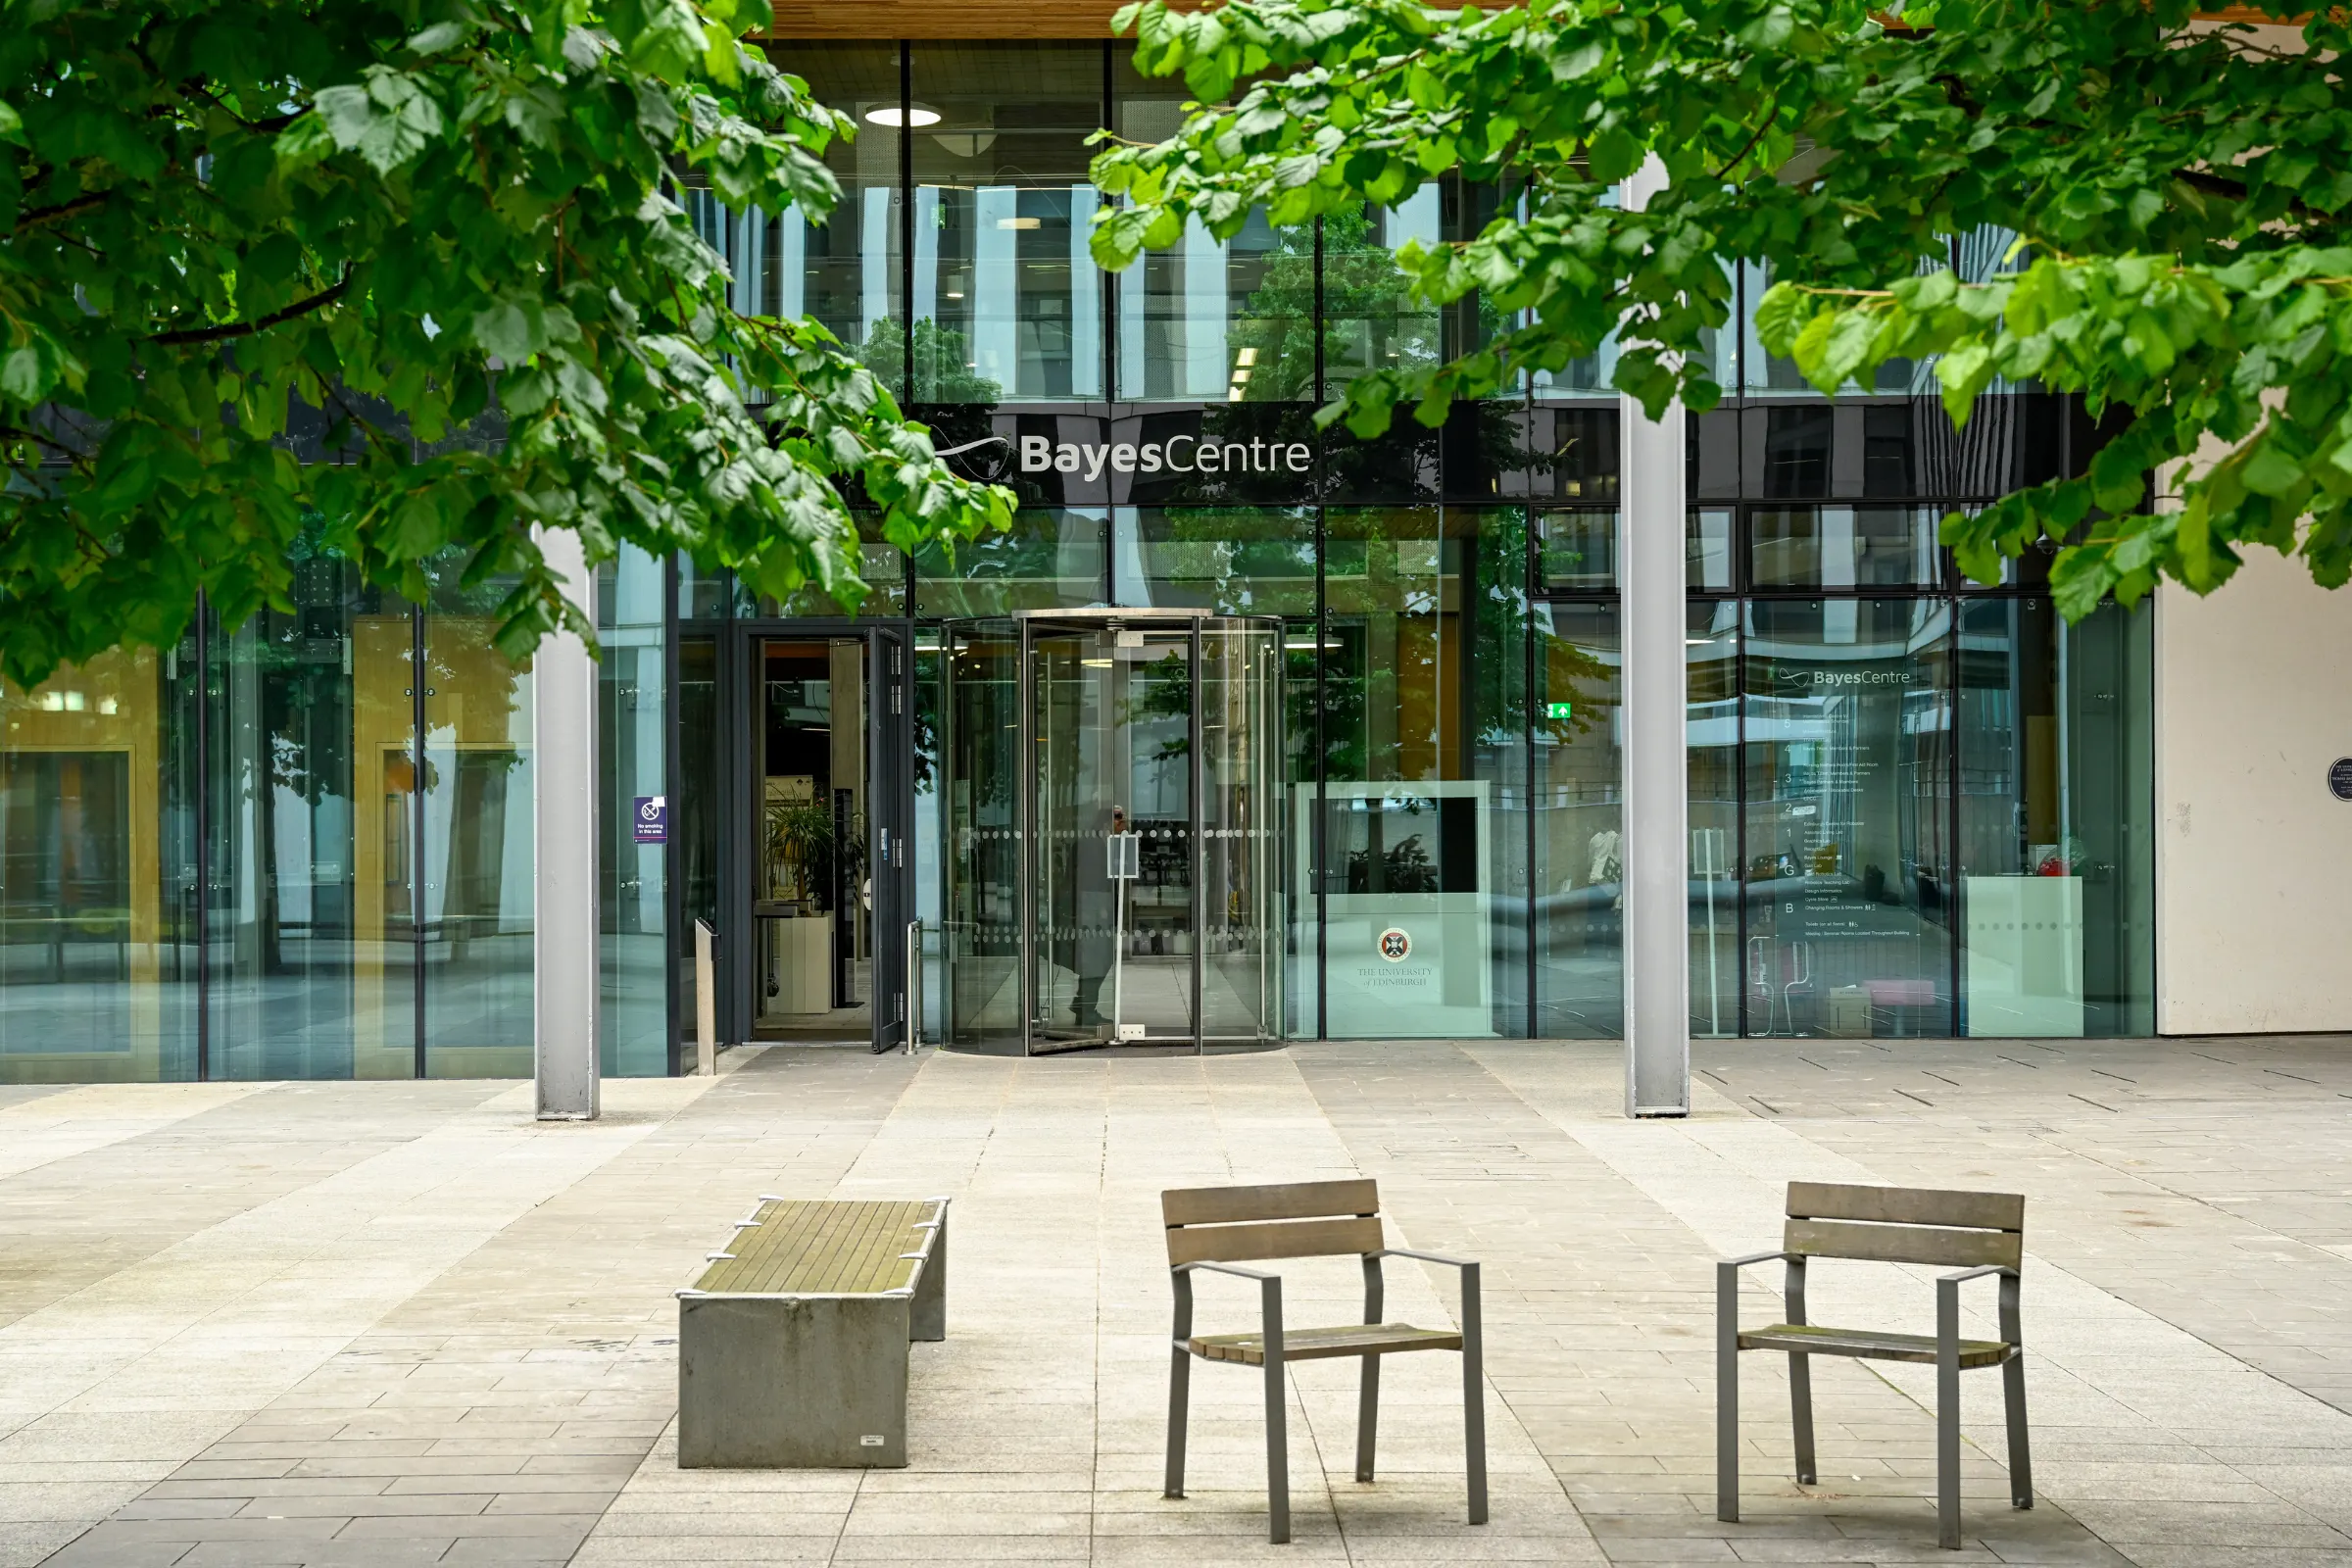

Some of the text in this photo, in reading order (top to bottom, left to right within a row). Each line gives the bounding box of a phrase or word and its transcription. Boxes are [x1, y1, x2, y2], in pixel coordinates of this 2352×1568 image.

[1020, 435, 1310, 482] BayesCentre
[1814, 670, 1910, 686] BayesCentre
[1784, 718, 1791, 728] 5
[1784, 745, 1791, 754] 4
[1785, 773, 1792, 783] 3
[1785, 803, 1792, 812] 2
[1787, 828, 1791, 838] 1
[1784, 864, 1794, 876] G
[1786, 903, 1794, 913] B
